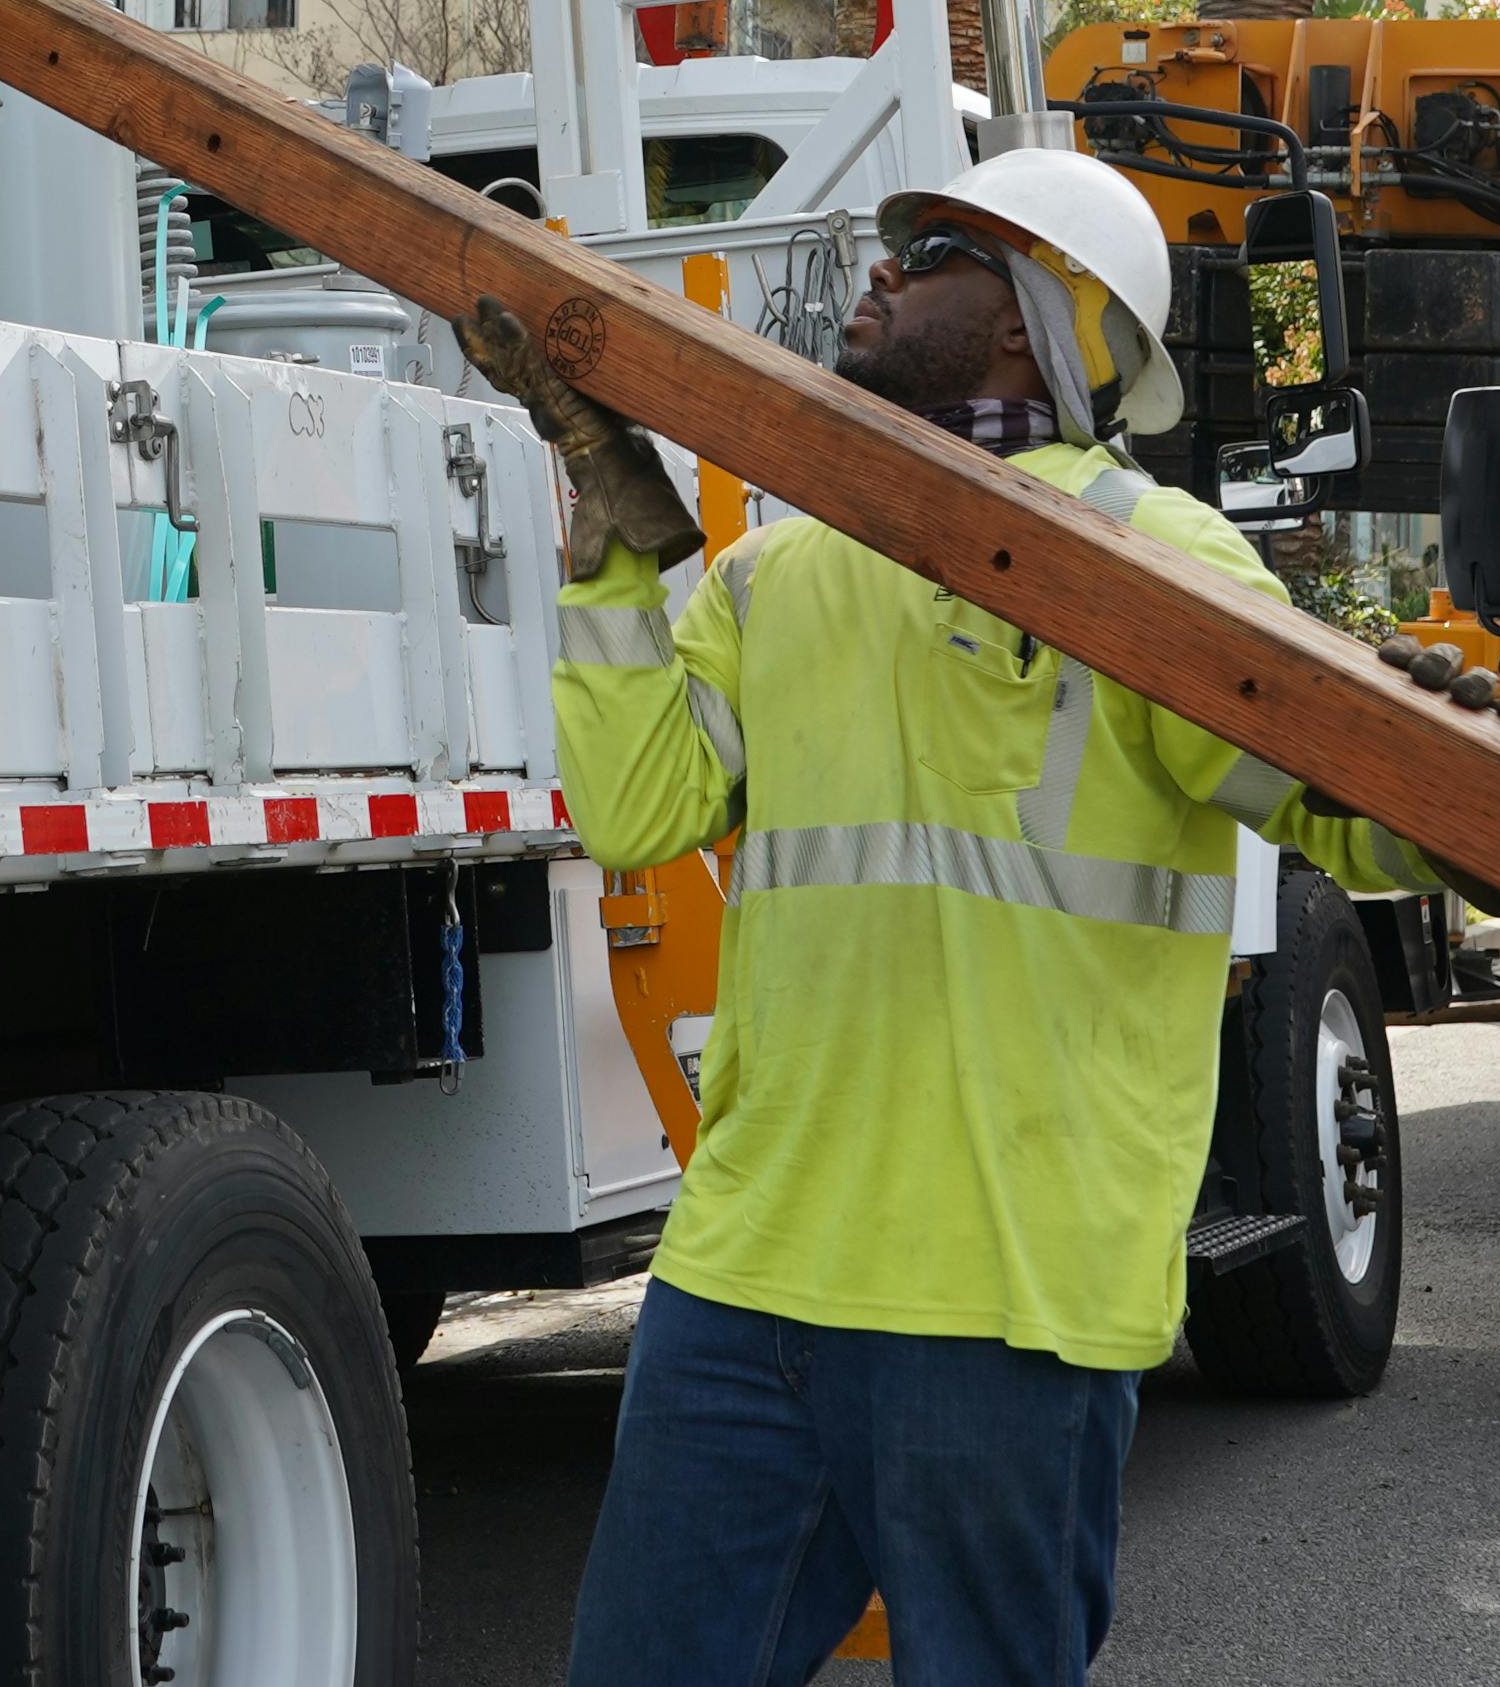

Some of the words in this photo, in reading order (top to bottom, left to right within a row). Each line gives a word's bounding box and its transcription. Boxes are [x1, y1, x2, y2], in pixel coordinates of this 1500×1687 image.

[548, 302, 577, 337] MADE
[586, 306, 597, 323] IN
[560, 326, 589, 353] TOP
[288, 391, 325, 439] CS3
